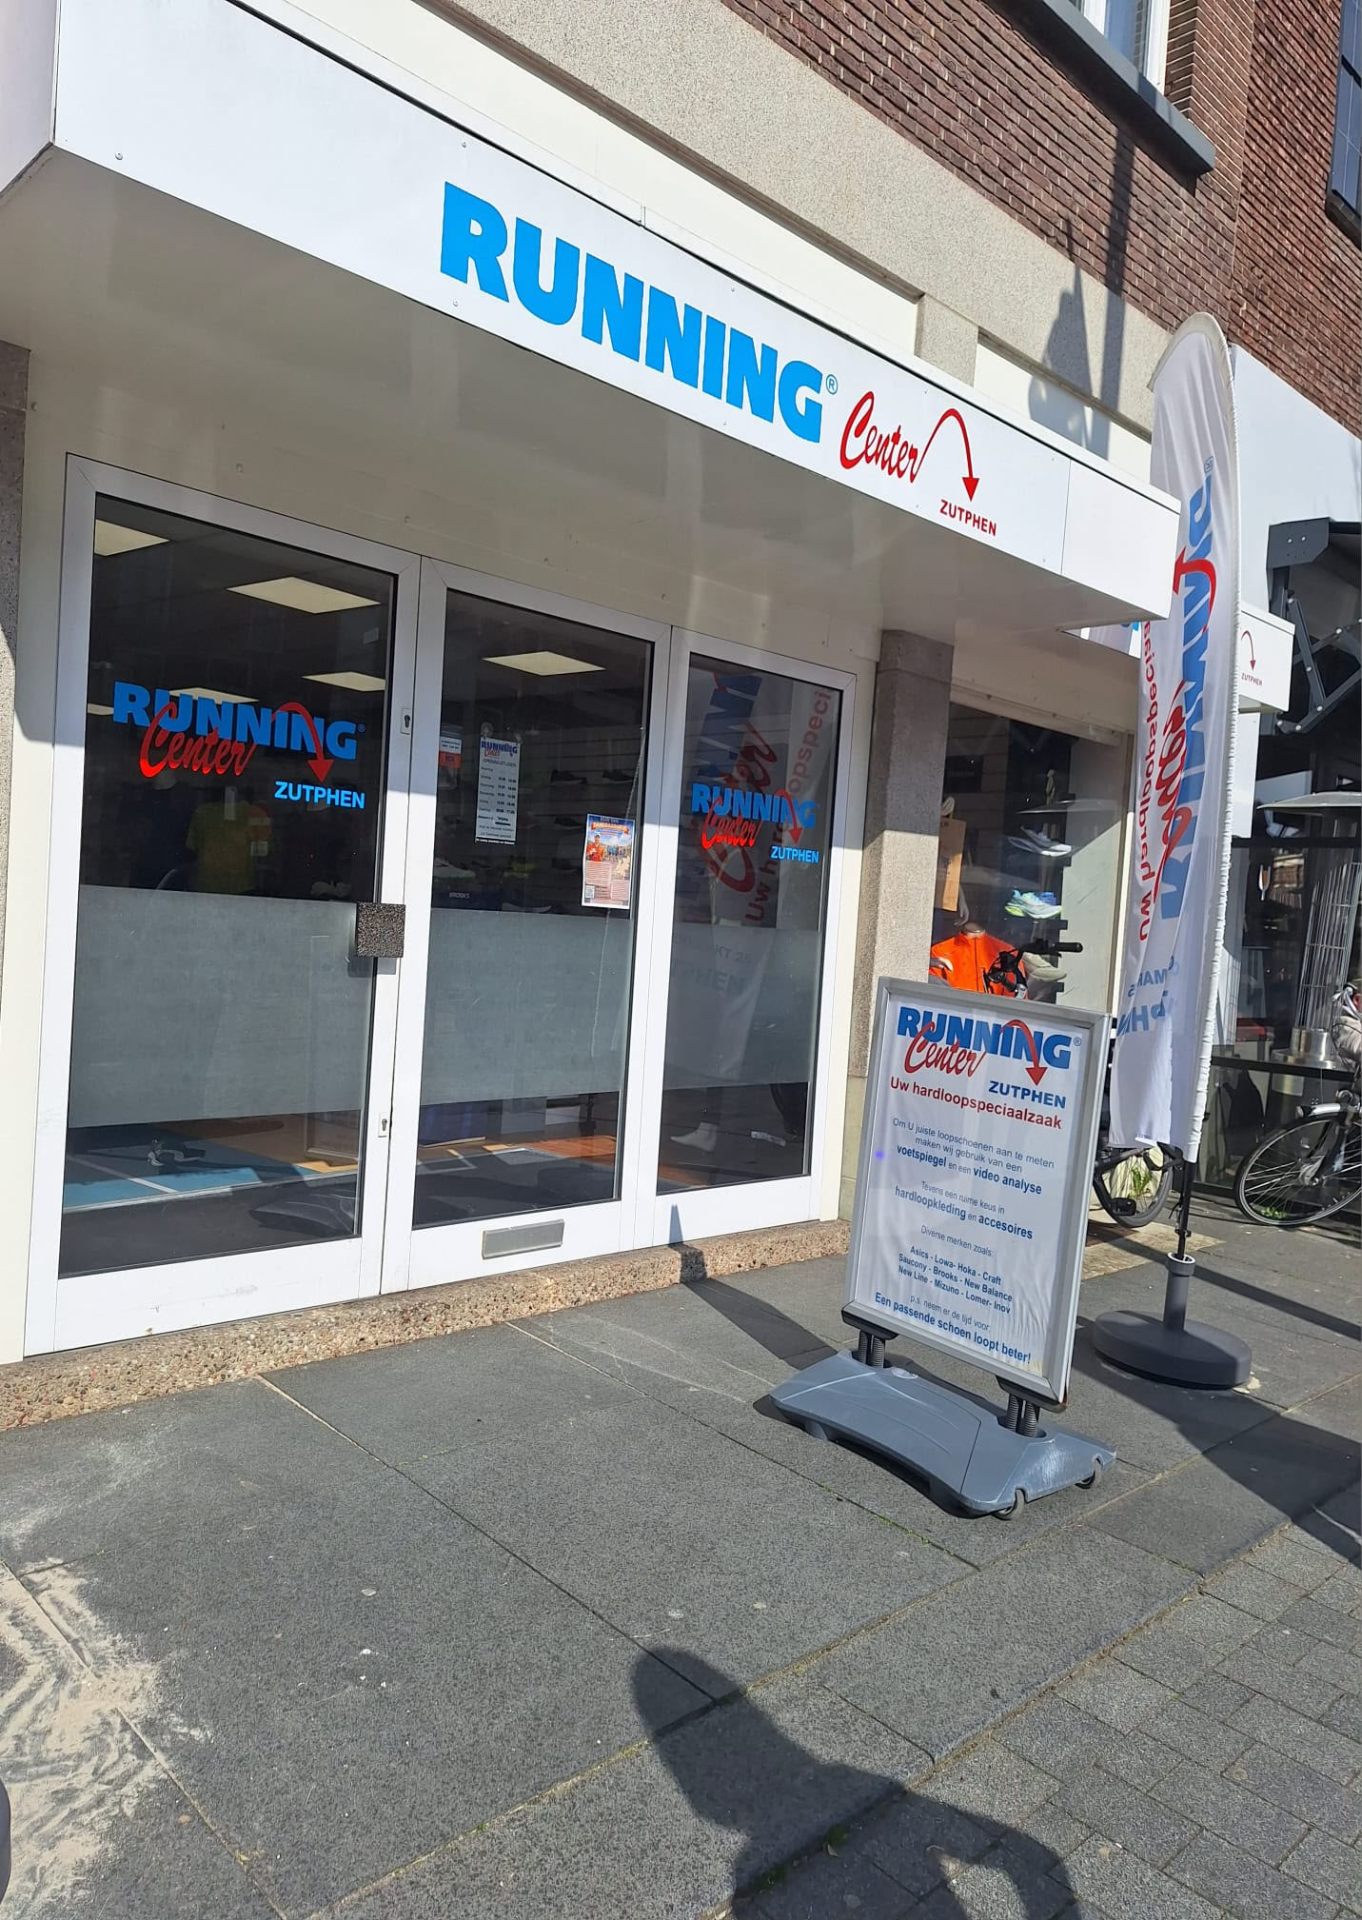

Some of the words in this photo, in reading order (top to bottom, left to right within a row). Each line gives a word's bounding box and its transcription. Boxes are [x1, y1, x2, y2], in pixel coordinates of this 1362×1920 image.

[440, 181, 822, 443] RUNNING
[839, 391, 923, 484] Center
[939, 499, 997, 537] ZUTPHEN
[113, 680, 358, 760] RUNNING
[139, 702, 257, 778] Center
[274, 781, 366, 809] ZUTPHEN
[691, 783, 817, 830] RUNNING
[770, 845, 819, 863] ZUTPHEN
[897, 1006, 1072, 1070] RUNNING
[904, 1021, 987, 1078] Center
[890, 1076, 910, 1093] Uw
[913, 1081, 1062, 1130] hardloopspeciaalzaak
[988, 1080, 1067, 1109] ZUTPHEN
[892, 1117, 906, 1129] Om
[908, 1122, 914, 1131] U
[915, 1124, 936, 1137] juiste
[937, 1129, 994, 1152] loopschoenen
[996, 1148, 1013, 1158] aan
[1014, 1151, 1023, 1161] te
[1025, 1154, 1055, 1169] meten
[915, 1136, 941, 1151] maken
[943, 1144, 954, 1156] wij
[955, 1147, 986, 1163] gebruik
[988, 1158, 1003, 1167] van
[1005, 1163, 1023, 1173] een
[896, 1145, 947, 1168] voetspiegel
[948, 1162, 957, 1170] en
[958, 1165, 971, 1175] een
[973, 1166, 1000, 1183] video
[1002, 1175, 1042, 1195] analyse
[895, 1185, 966, 1221] hardloopkleding
[967, 1213, 977, 1222] en
[978, 1214, 1033, 1240] accesoires
[921, 1180, 944, 1195] Tevens
[945, 1190, 958, 1199] een
[959, 1194, 979, 1206] ruime
[979, 1200, 997, 1212] keus
[998, 1203, 1005, 1215] in
[921, 1225, 946, 1241] Diverse
[947, 1235, 972, 1251] merken
[898, 1253, 927, 1273] Saucony
[932, 1266, 958, 1283] Brooks
[964, 1278, 980, 1290] New
[982, 1283, 1013, 1302] Balance
[898, 1265, 912, 1277] New
[913, 1270, 928, 1284] Line
[934, 1279, 960, 1295] Mizuno
[910, 1246, 929, 1260] Asics
[957, 1262, 976, 1277] Hoka
[982, 1271, 1002, 1286] Craft
[875, 1292, 892, 1308] Een
[893, 1300, 936, 1325] passende
[937, 1320, 972, 1340] schoen
[974, 1331, 999, 1351] loopt
[1001, 1343, 1031, 1364] beter!
[923, 1300, 942, 1313] neem
[943, 1307, 950, 1315] er
[952, 1310, 960, 1321] de
[962, 1314, 972, 1326] tijd
